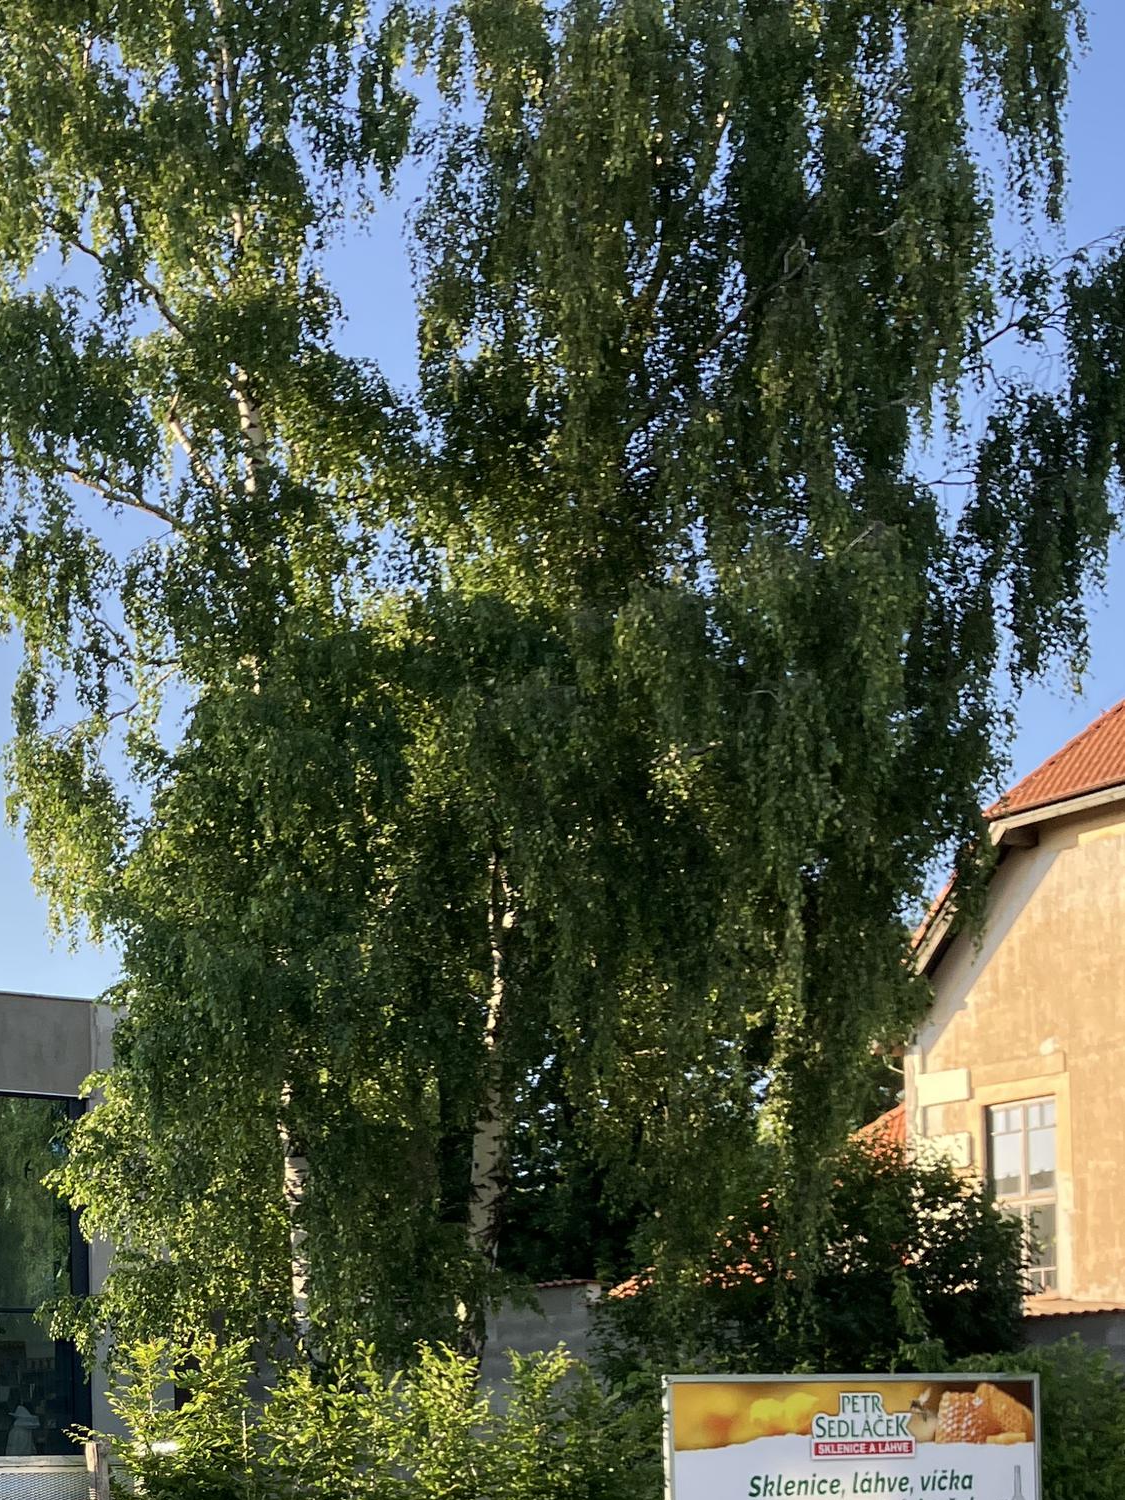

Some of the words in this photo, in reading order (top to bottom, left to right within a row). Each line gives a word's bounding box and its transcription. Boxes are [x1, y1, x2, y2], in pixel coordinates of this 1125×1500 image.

[841, 1395, 882, 1413] PETR
[815, 1415, 909, 1438] SEDLÁČEK
[818, 1443, 867, 1455] SKLENICE
[869, 1442, 876, 1454] A
[879, 1440, 909, 1453] LÁHVE
[748, 1473, 846, 1498] Sklenice,
[852, 1471, 914, 1495] láhve,
[920, 1469, 974, 1492] víčka
